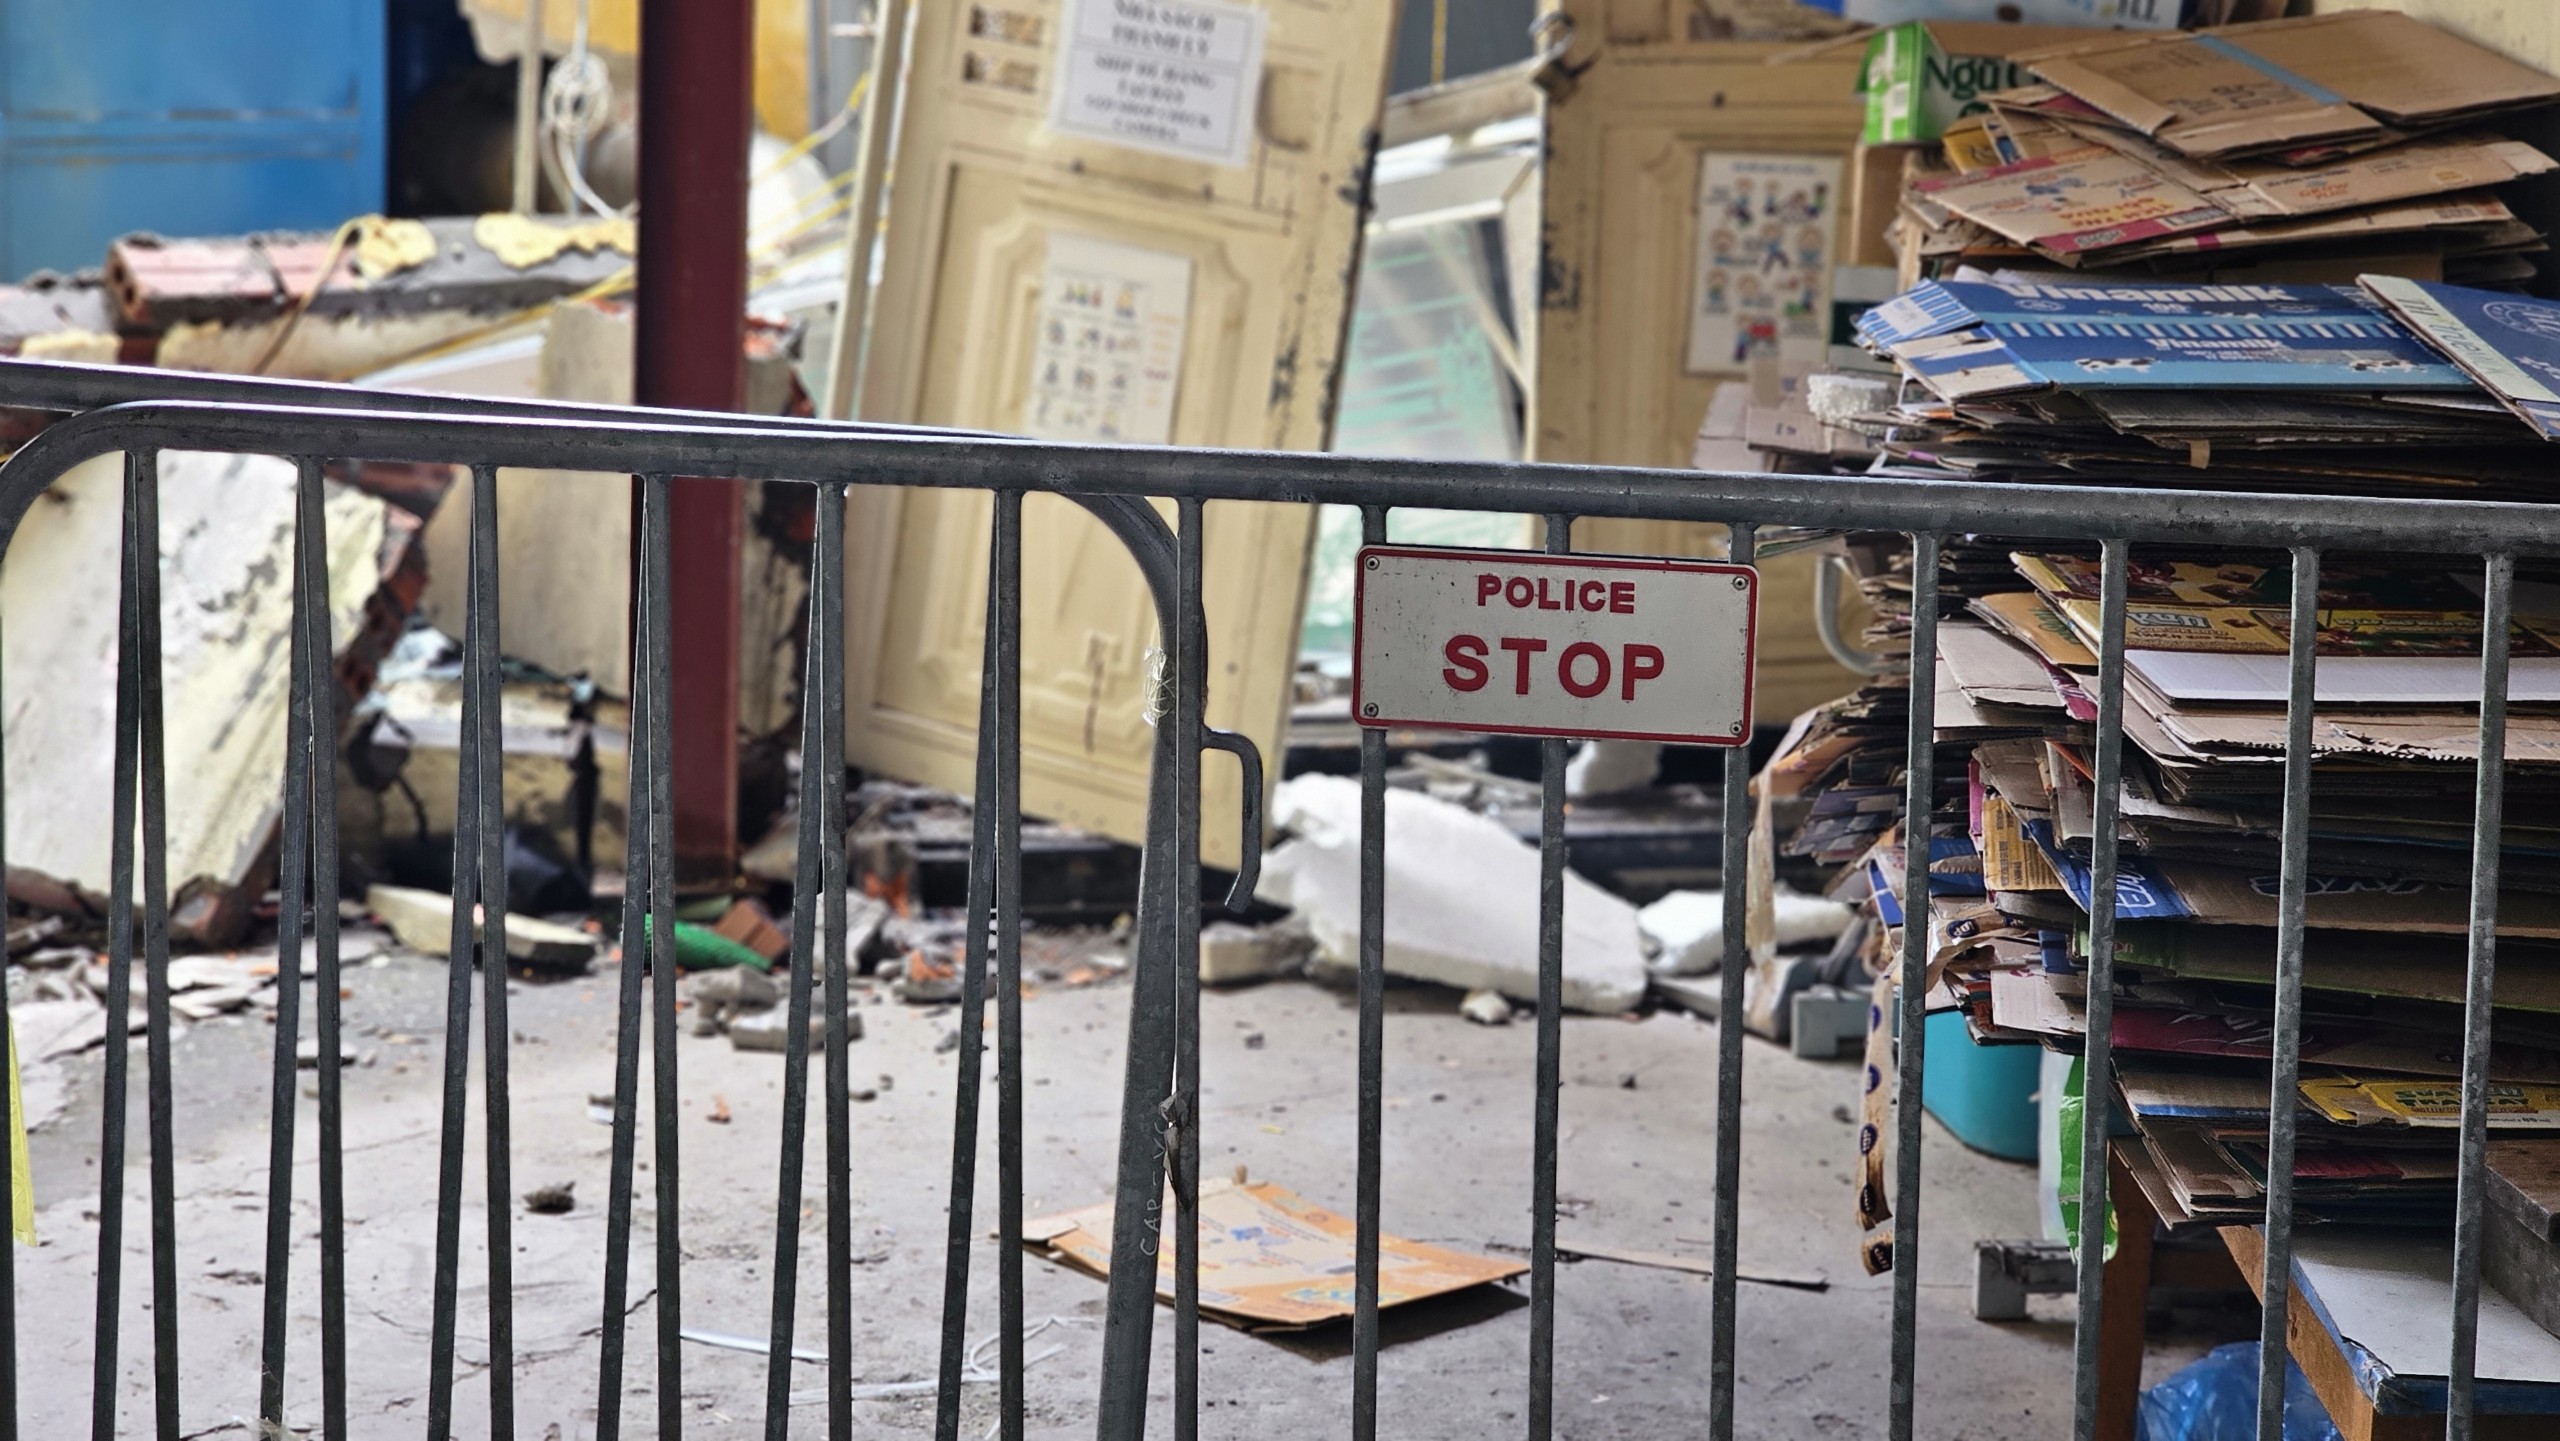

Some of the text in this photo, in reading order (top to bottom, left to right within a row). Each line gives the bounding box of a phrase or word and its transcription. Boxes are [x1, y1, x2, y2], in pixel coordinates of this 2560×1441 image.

[1996, 285, 2301, 302] Vinamilk
[2145, 339, 2287, 351] Vinamilk
[1477, 575, 1635, 614] POLICE
[1442, 634, 1665, 701] STOP
